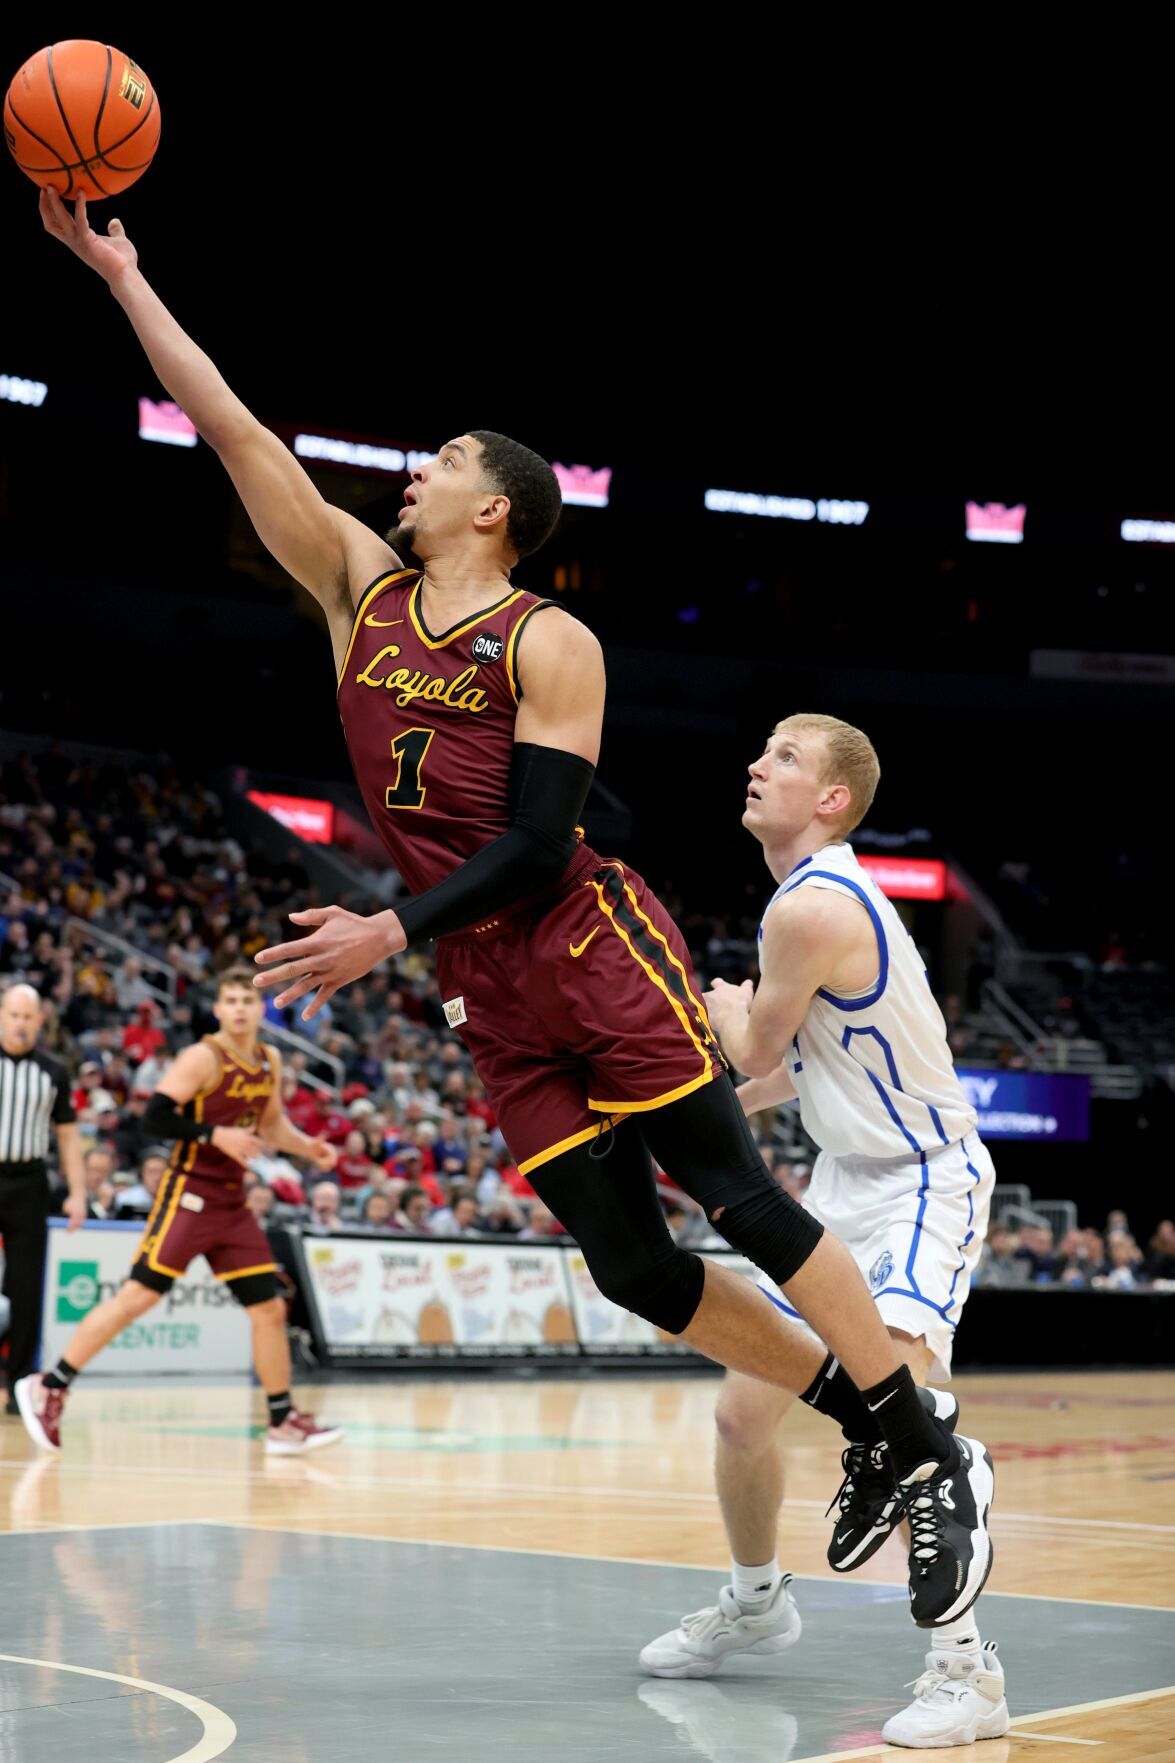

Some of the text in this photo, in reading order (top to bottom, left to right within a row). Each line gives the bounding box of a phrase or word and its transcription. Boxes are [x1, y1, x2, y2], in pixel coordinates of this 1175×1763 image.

[704, 488, 816, 521] ESTABLISHED
[474, 637, 502, 658] ONE
[356, 644, 489, 713] Loyola
[385, 727, 436, 810] 1
